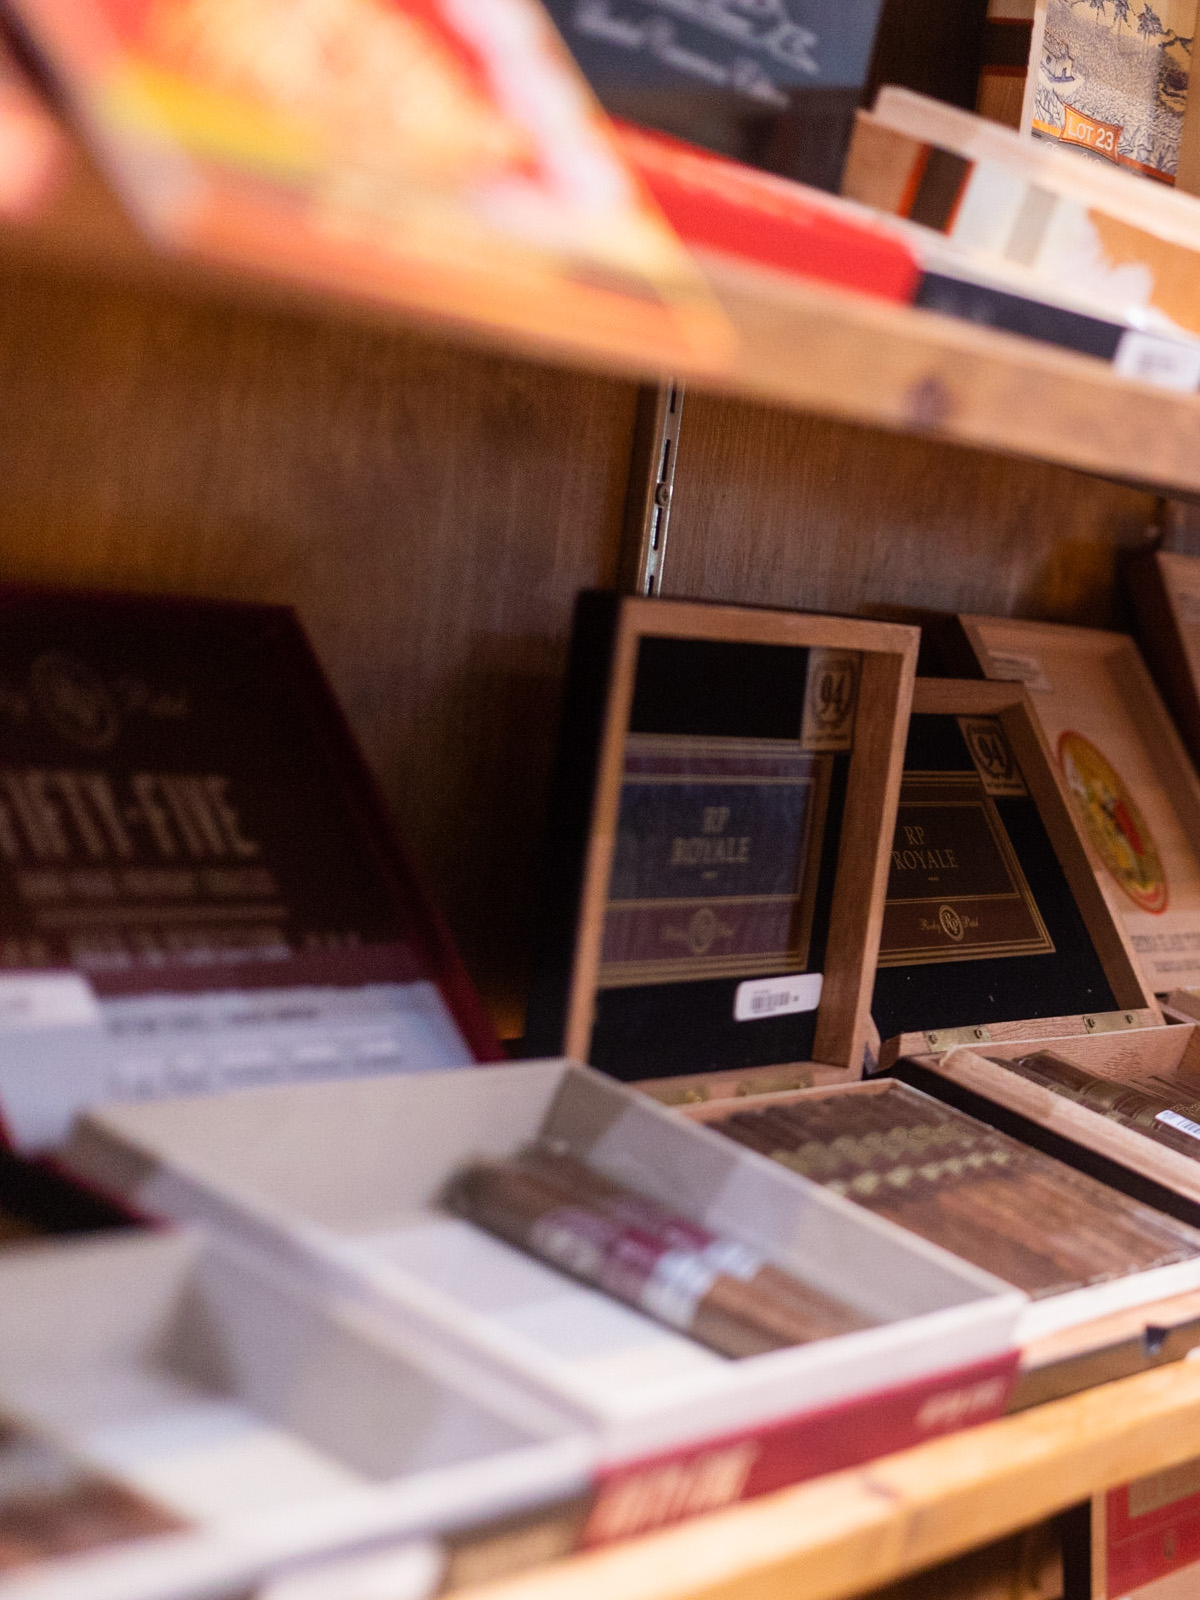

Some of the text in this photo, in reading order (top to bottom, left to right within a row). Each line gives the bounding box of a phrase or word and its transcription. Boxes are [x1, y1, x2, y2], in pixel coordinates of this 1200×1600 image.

[1067, 115, 1114, 152] LOT 23
[903, 825, 926, 846] RP
[670, 836, 750, 866] ROYALE
[892, 849, 958, 871] ROYALE
